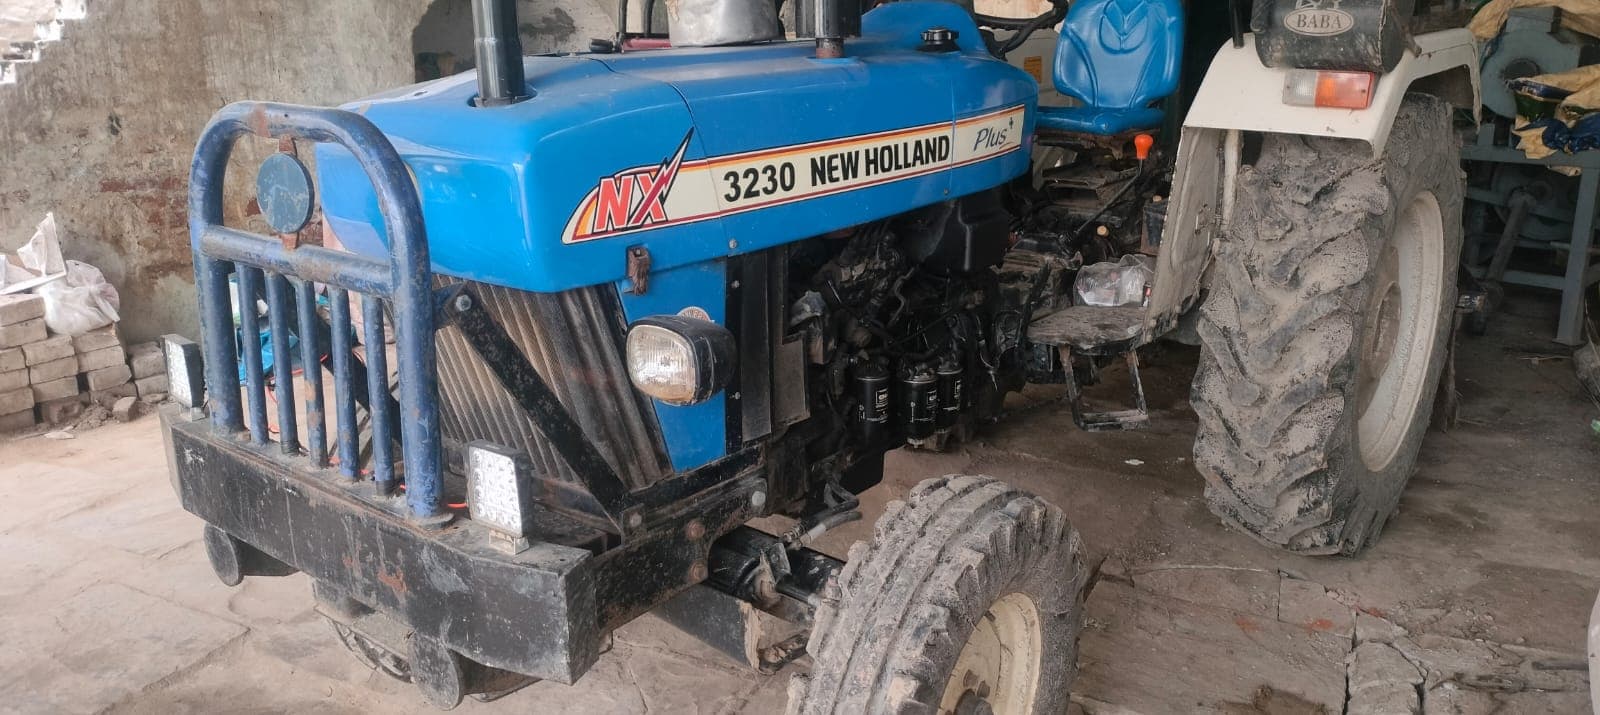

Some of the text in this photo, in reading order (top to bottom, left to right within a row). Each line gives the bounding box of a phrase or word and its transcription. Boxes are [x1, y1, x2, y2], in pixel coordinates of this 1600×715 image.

[1297, 14, 1342, 28] BABA
[724, 161, 796, 202] 3230
[811, 151, 860, 187] NEW
[865, 135, 951, 176] HOLLAND
